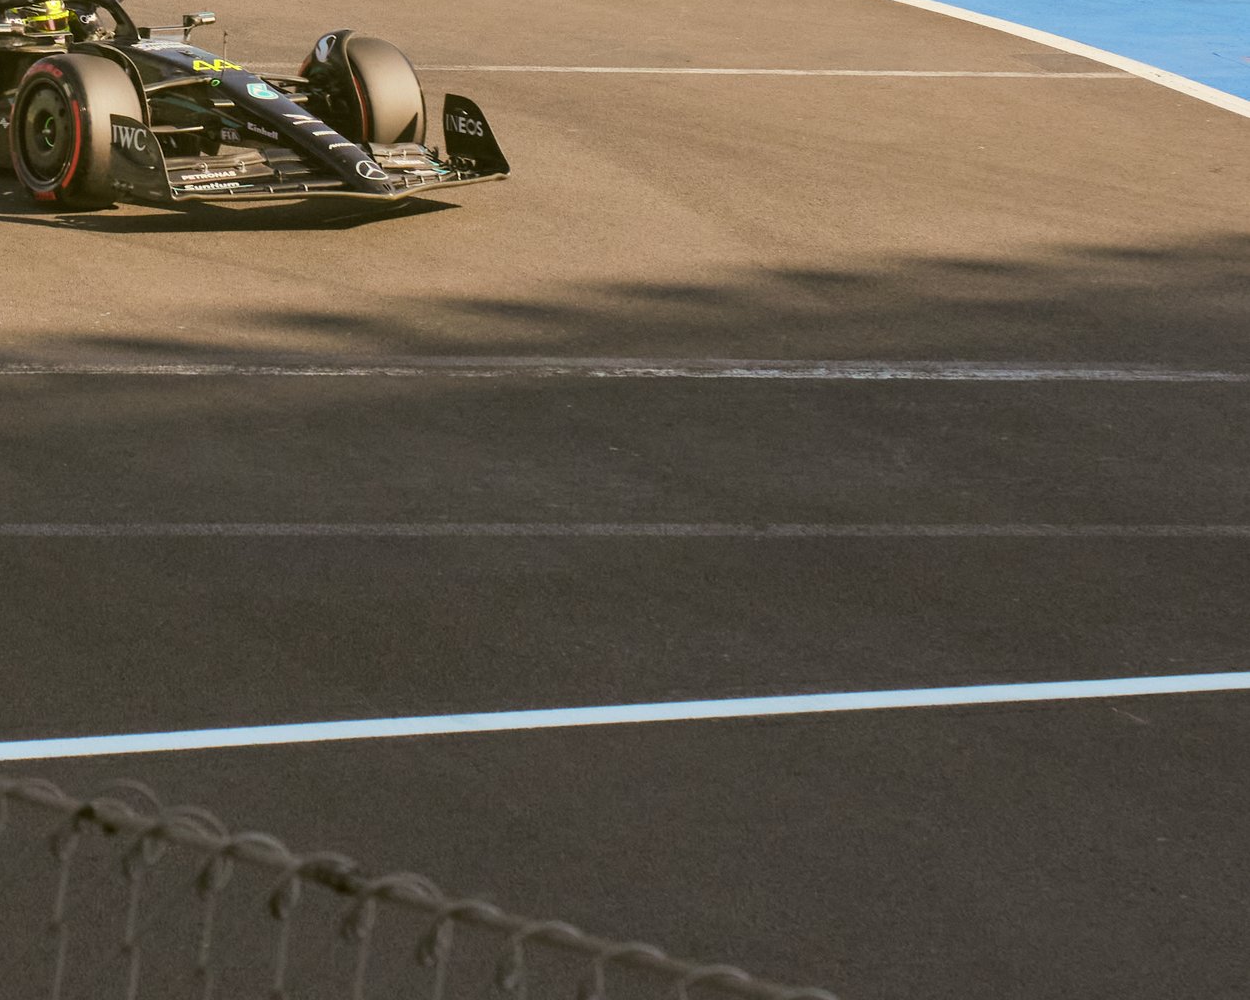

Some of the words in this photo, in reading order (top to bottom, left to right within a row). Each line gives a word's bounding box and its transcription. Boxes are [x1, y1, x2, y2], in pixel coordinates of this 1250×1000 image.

[247, 122, 279, 140] Einhell
[446, 114, 483, 137] INEOS
[112, 124, 147, 151] IWC
[181, 170, 237, 182] PETRONAS
